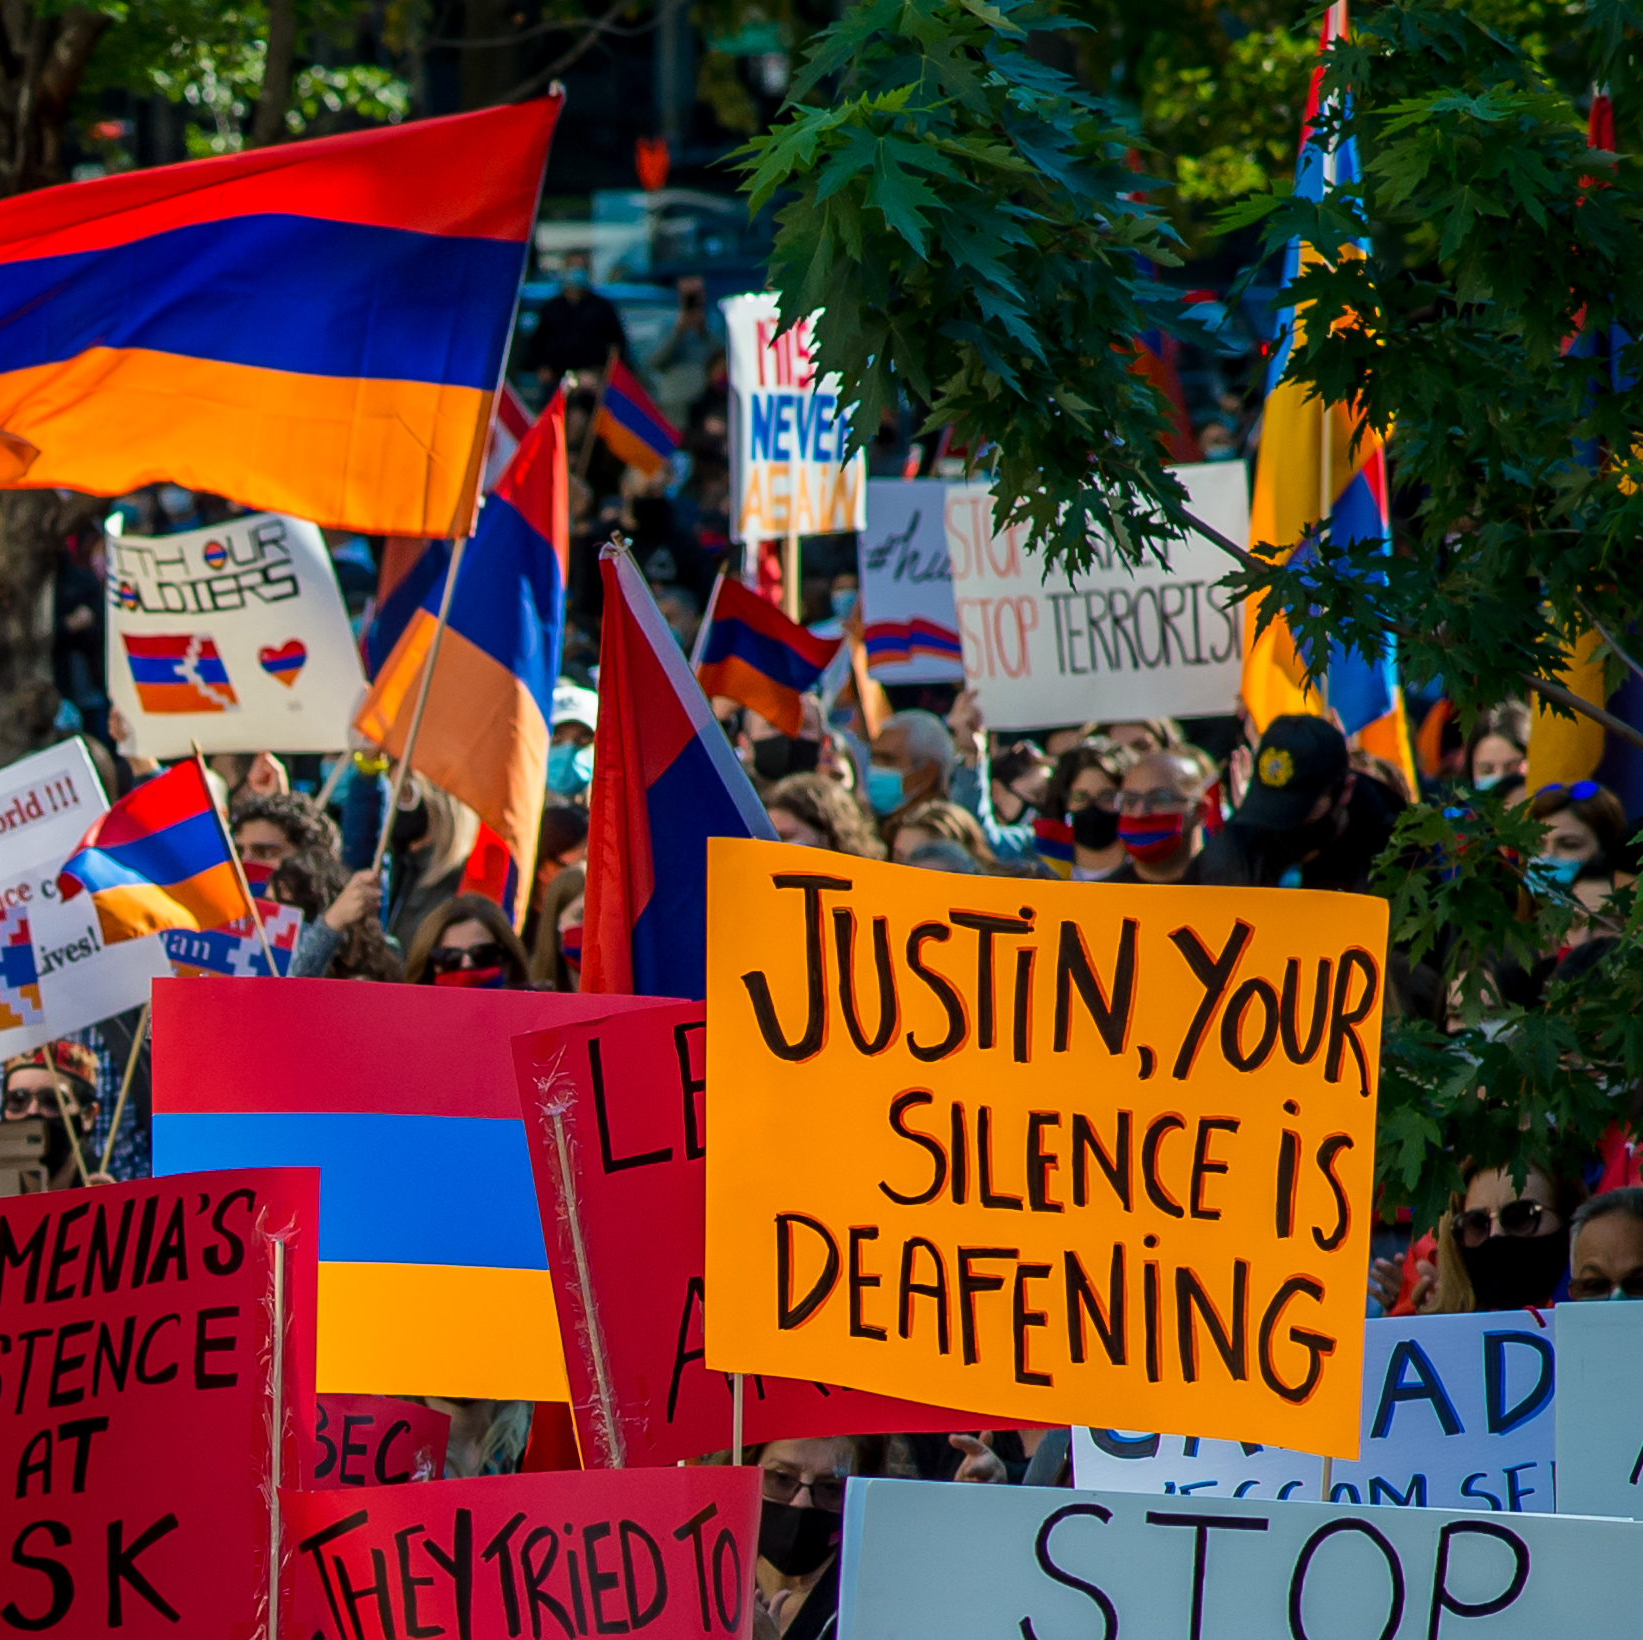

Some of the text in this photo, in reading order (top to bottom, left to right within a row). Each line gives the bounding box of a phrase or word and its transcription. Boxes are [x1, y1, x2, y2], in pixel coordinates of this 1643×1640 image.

[957, 596, 1040, 680] STOP
[1168, 918, 1382, 1098] YOUR
[878, 1089, 1241, 1221] SILENCE
[14, 1415, 110, 1501] AT
[674, 1502, 743, 1634] TO
